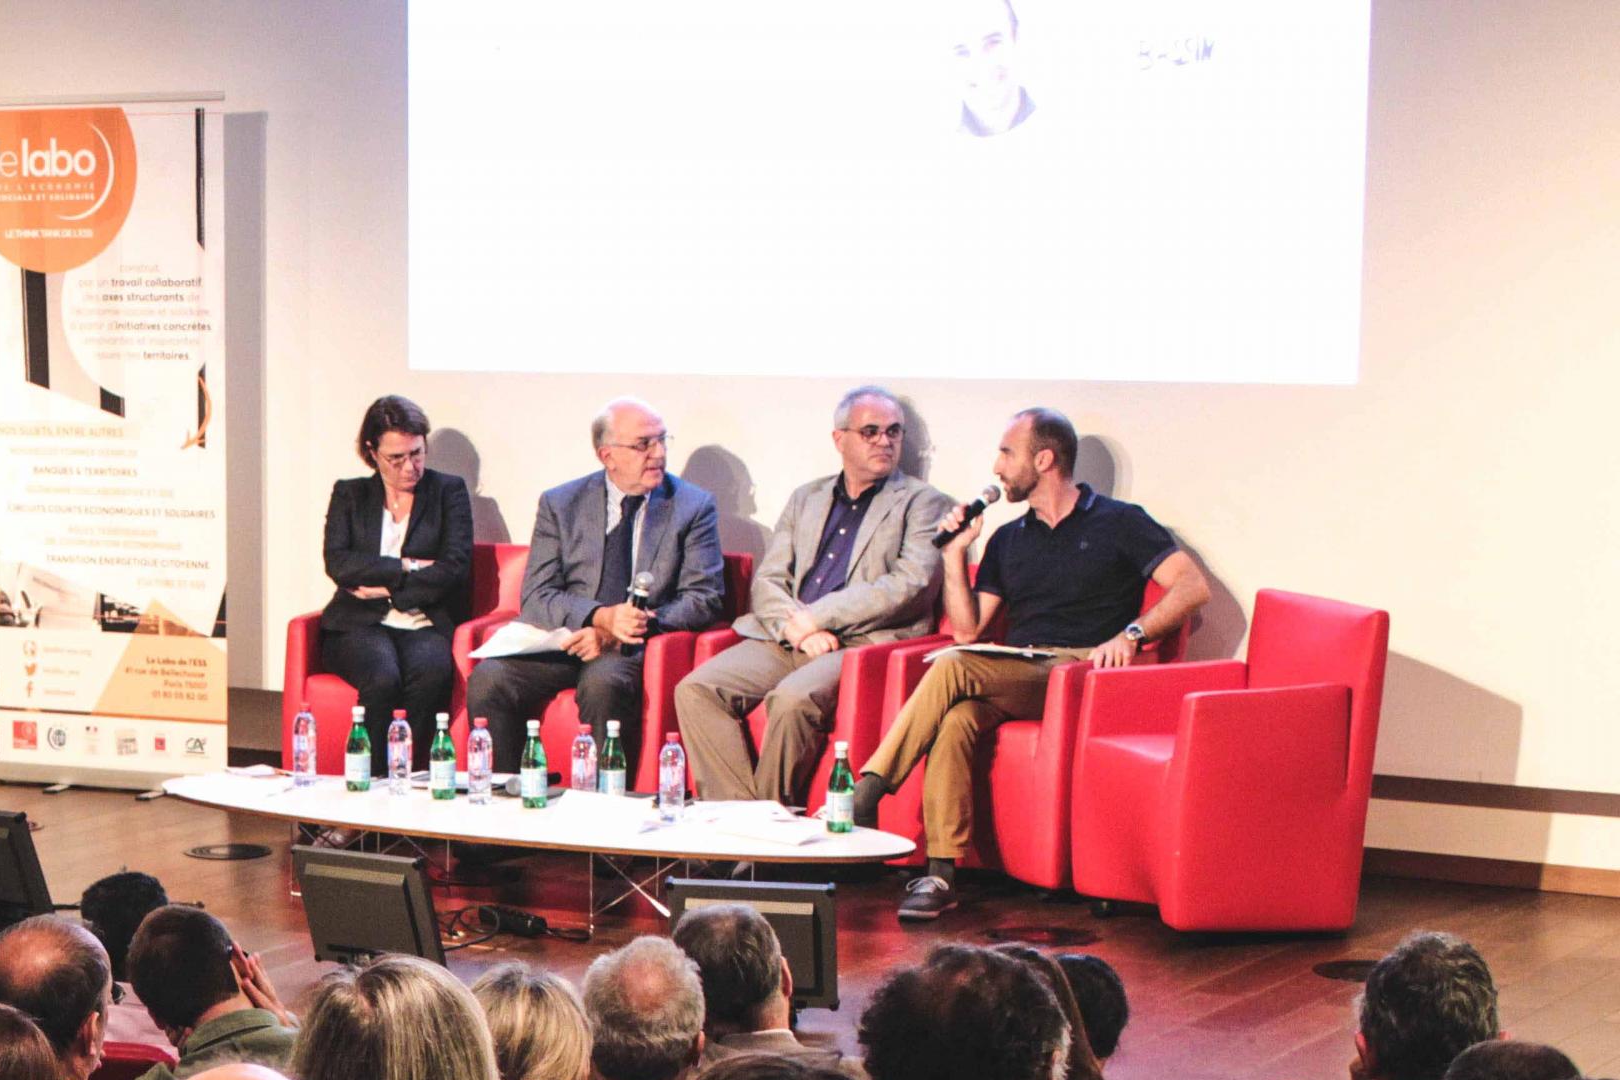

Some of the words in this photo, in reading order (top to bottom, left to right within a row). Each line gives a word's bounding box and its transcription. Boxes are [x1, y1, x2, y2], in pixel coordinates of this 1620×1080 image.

[21, 137, 97, 178] labo
[111, 277, 143, 287] travail
[145, 276, 202, 288] collaboratif
[102, 293, 124, 302] axes
[126, 291, 184, 302] structurants
[56, 425, 86, 437] ENTRE
[89, 426, 124, 438] AUTRES
[32, 466, 74, 477] BANQUES
[85, 467, 138, 478] TERRITOIRES
[48, 504, 82, 515] COURTS
[164, 508, 216, 520] SOLIDAIRES
[46, 554, 97, 565] TRANSITION
[160, 558, 210, 570] CITOYENNE
